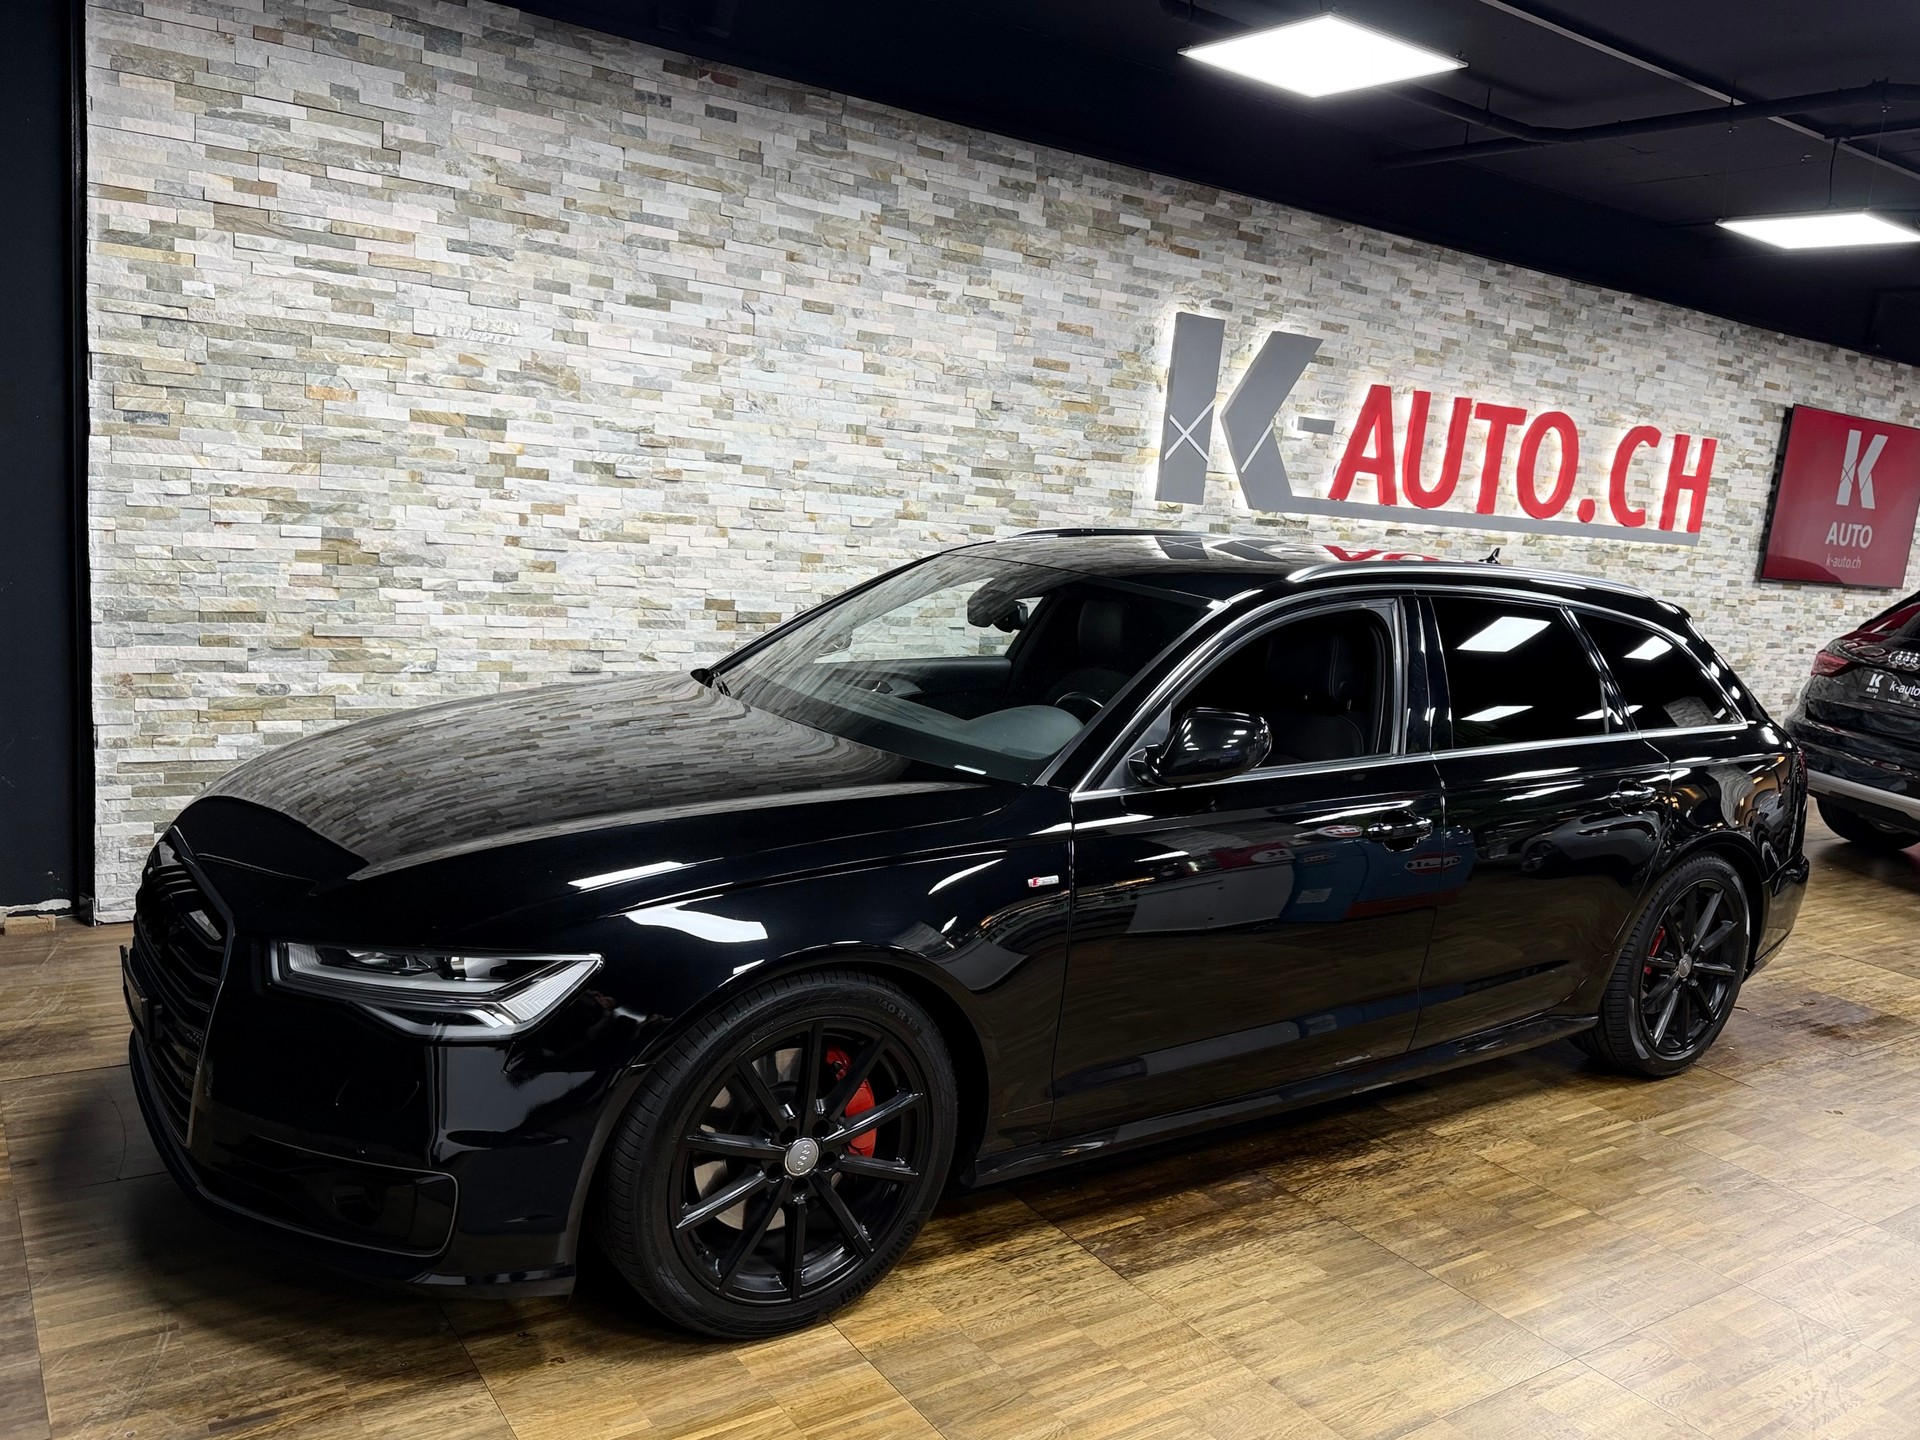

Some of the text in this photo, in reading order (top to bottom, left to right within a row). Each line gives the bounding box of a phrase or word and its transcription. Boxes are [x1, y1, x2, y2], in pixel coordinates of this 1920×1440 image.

[1154, 311, 1717, 534] K-AUTO.CH
[1835, 428, 1889, 510] K
[1825, 521, 1873, 549] AUTO
[1825, 553, 1862, 569] k-auto.ch
[1870, 673, 1884, 687] K
